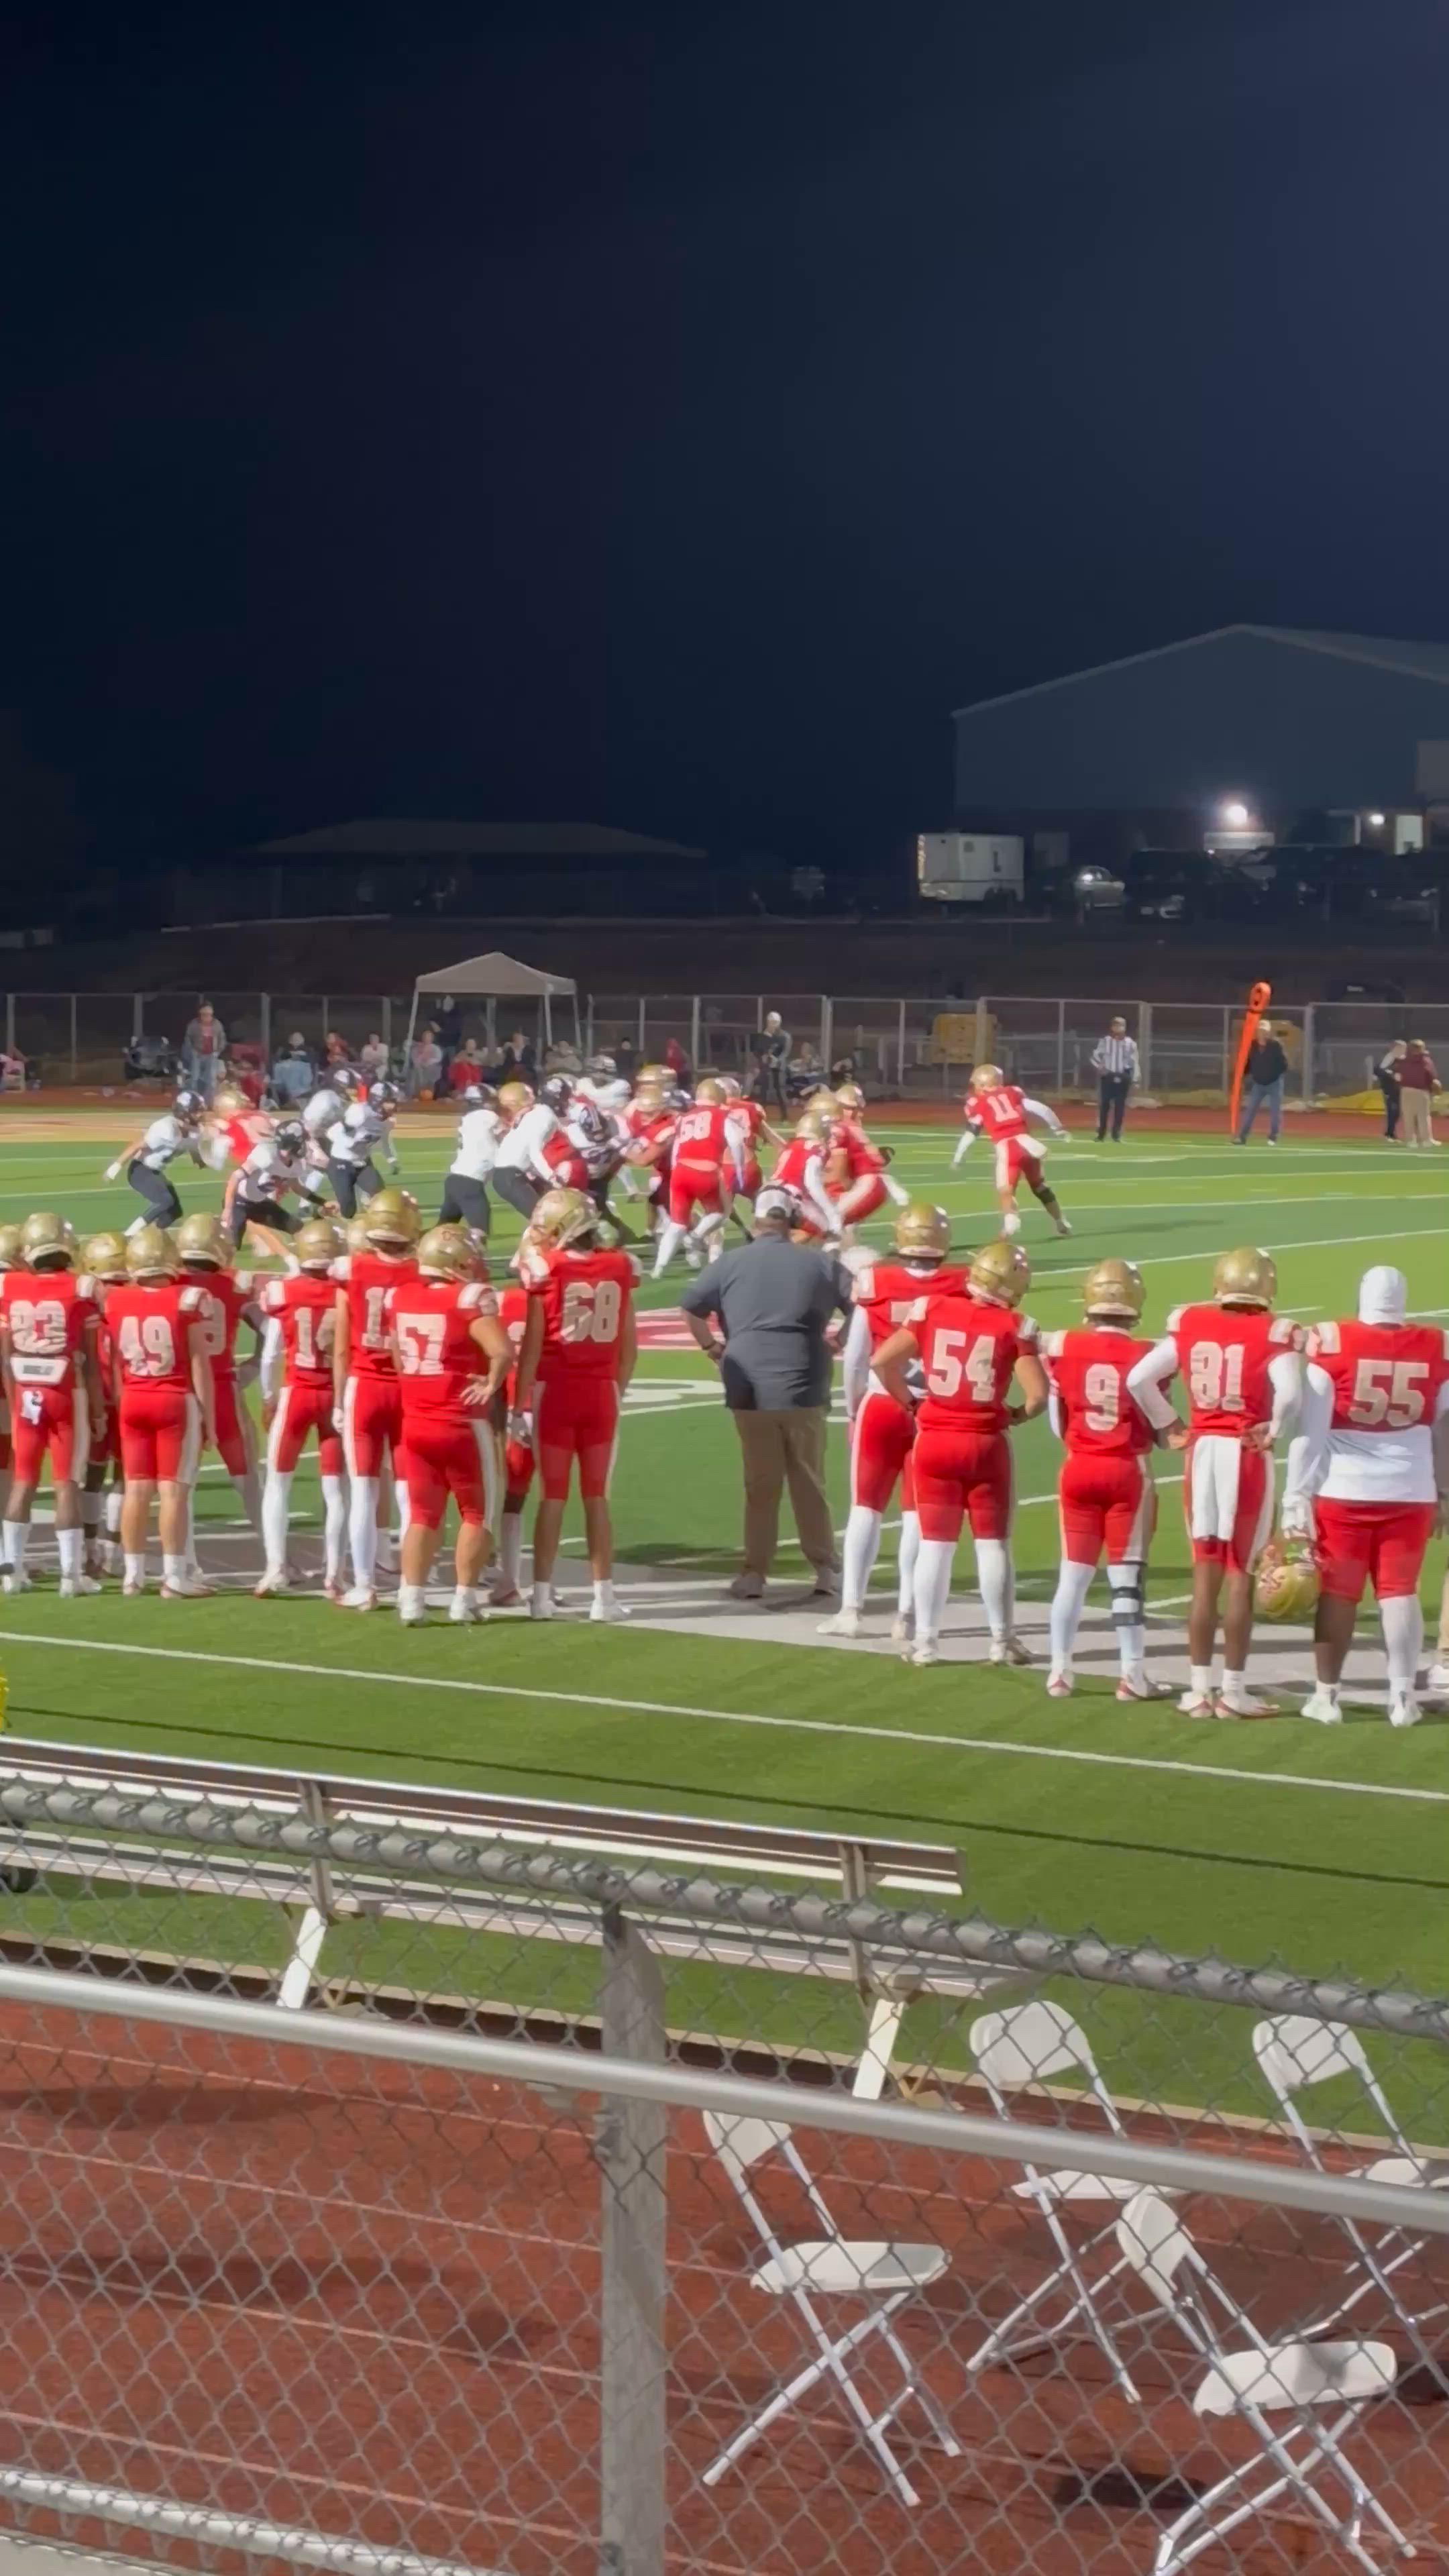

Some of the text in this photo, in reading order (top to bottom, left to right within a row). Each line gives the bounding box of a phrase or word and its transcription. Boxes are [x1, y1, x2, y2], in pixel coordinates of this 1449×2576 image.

[987, 1093, 1020, 1122] 11
[396, 1312, 446, 1375] 57
[561, 1281, 621, 1342] 68
[119, 1316, 175, 1376] 49
[928, 1329, 996, 1402] 54
[1190, 1341, 1246, 1411] 81
[1084, 1363, 1120, 1431] 9
[1348, 1358, 1430, 1428] 55
